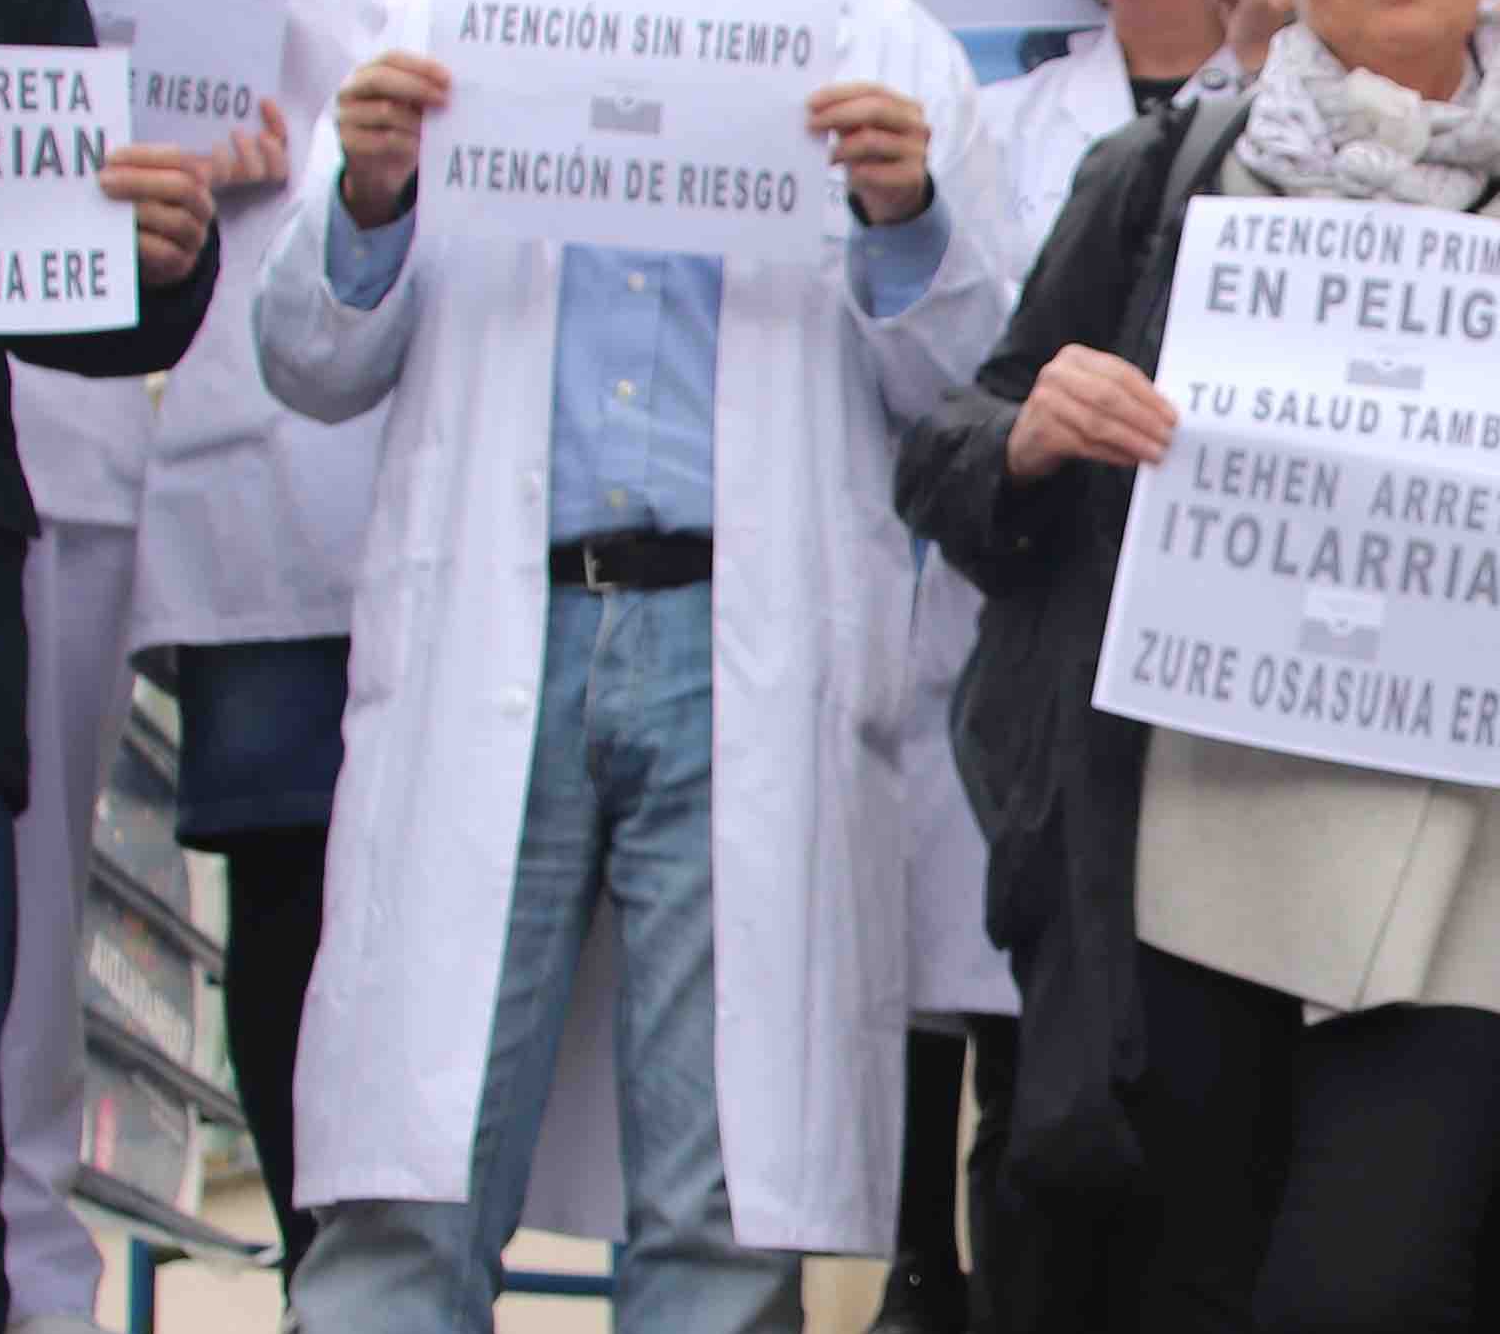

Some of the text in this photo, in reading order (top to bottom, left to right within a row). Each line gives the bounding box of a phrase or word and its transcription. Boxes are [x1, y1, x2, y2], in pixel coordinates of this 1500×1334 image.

[461, 1, 812, 67] ATENCIÓN SIN TIEMPO
[147, 69, 251, 117] RIESGO
[446, 144, 795, 212] ATENCIÓN DE RIESGO
[1218, 212, 1403, 265] ATENCIÓN
[43, 250, 107, 299] ERE
[1206, 263, 1287, 318] EN
[1190, 383, 1234, 416] TU
[1253, 388, 1379, 434] SALUD
[1194, 444, 1339, 508] LEHEN
[1134, 630, 1238, 700] ZURE
[1251, 655, 1434, 737] OSASUNA
